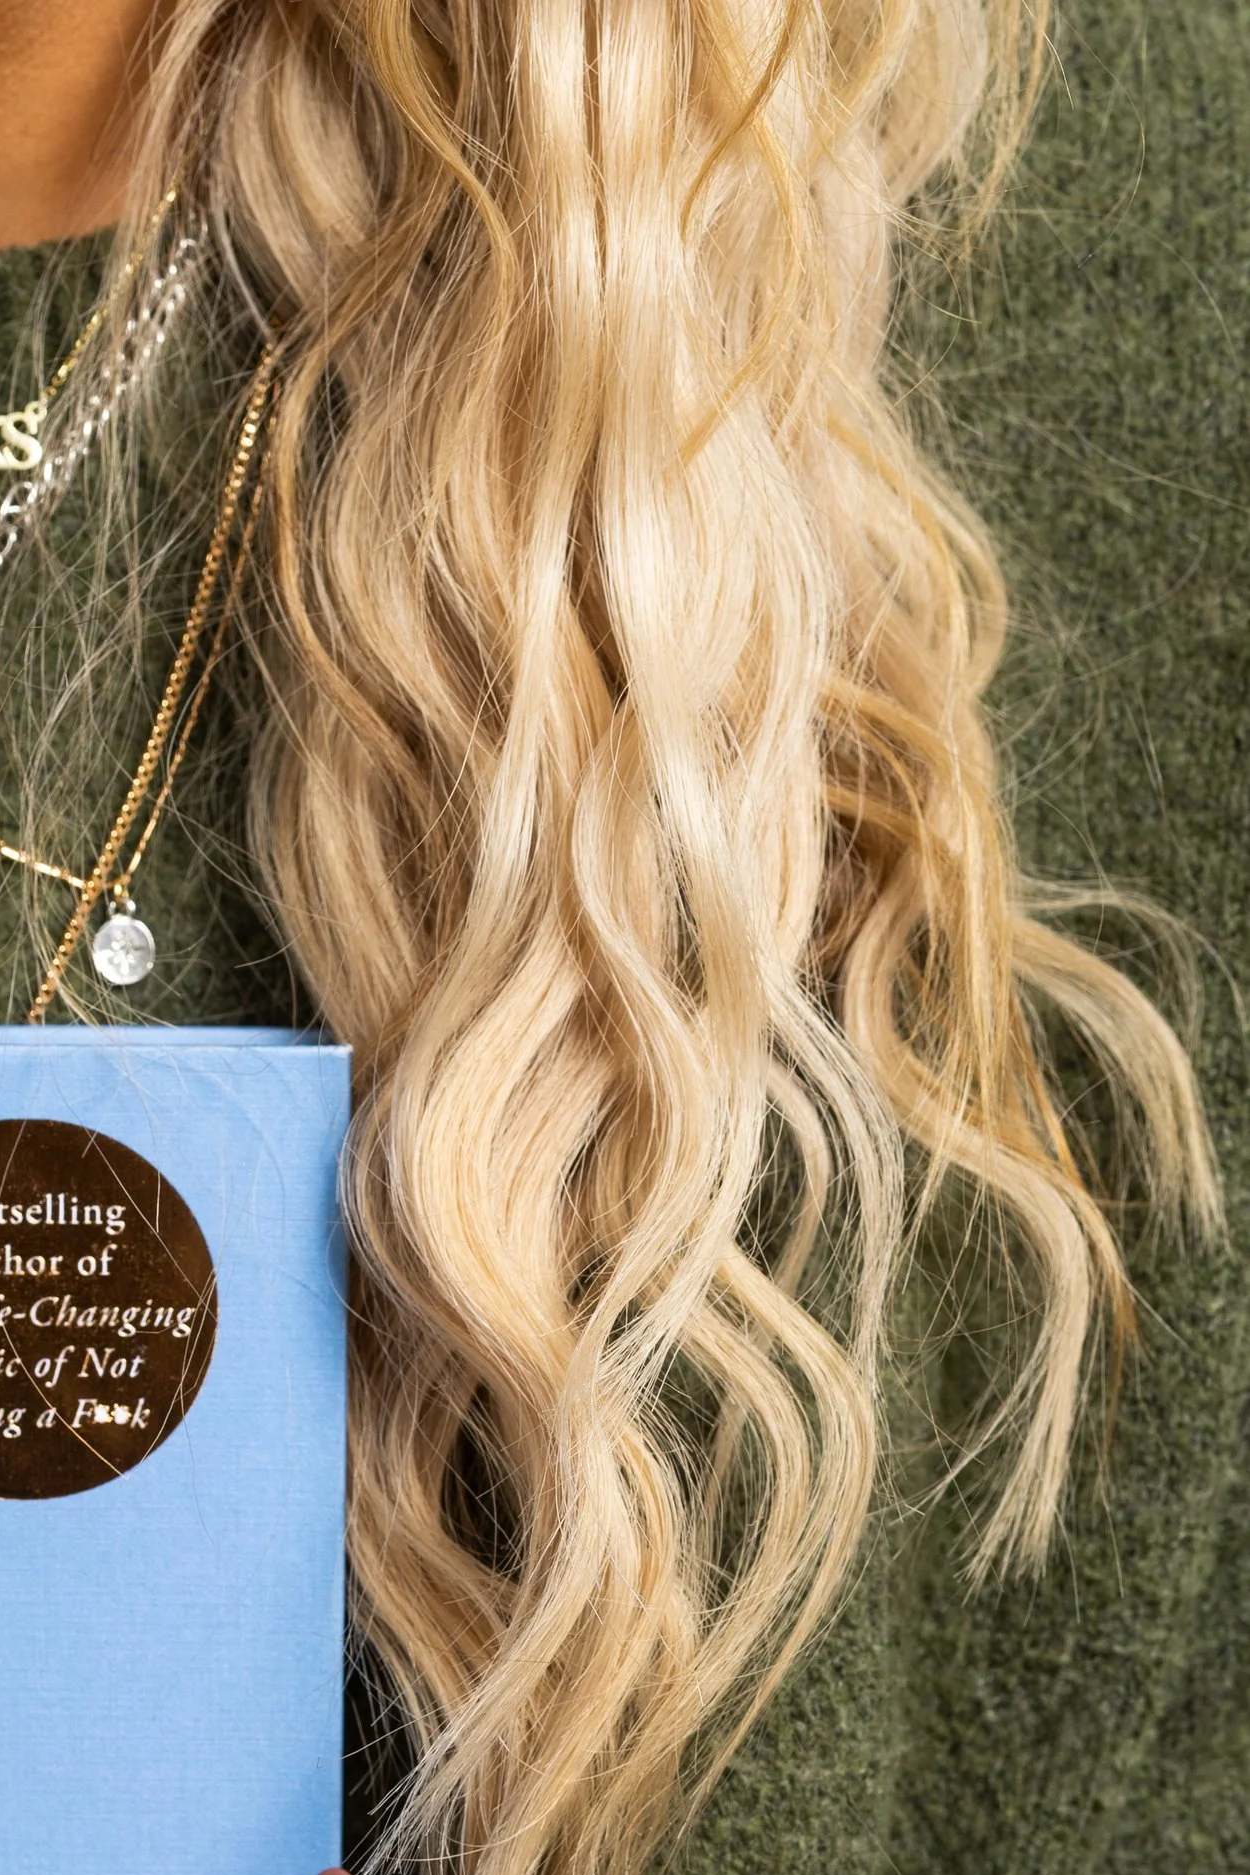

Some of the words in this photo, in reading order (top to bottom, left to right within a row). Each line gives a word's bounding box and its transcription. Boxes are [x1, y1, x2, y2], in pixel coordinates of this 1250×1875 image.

[77, 1244, 118, 1276] of
[33, 1345, 75, 1387] of
[78, 1347, 145, 1378] Not
[36, 1407, 56, 1429] a
